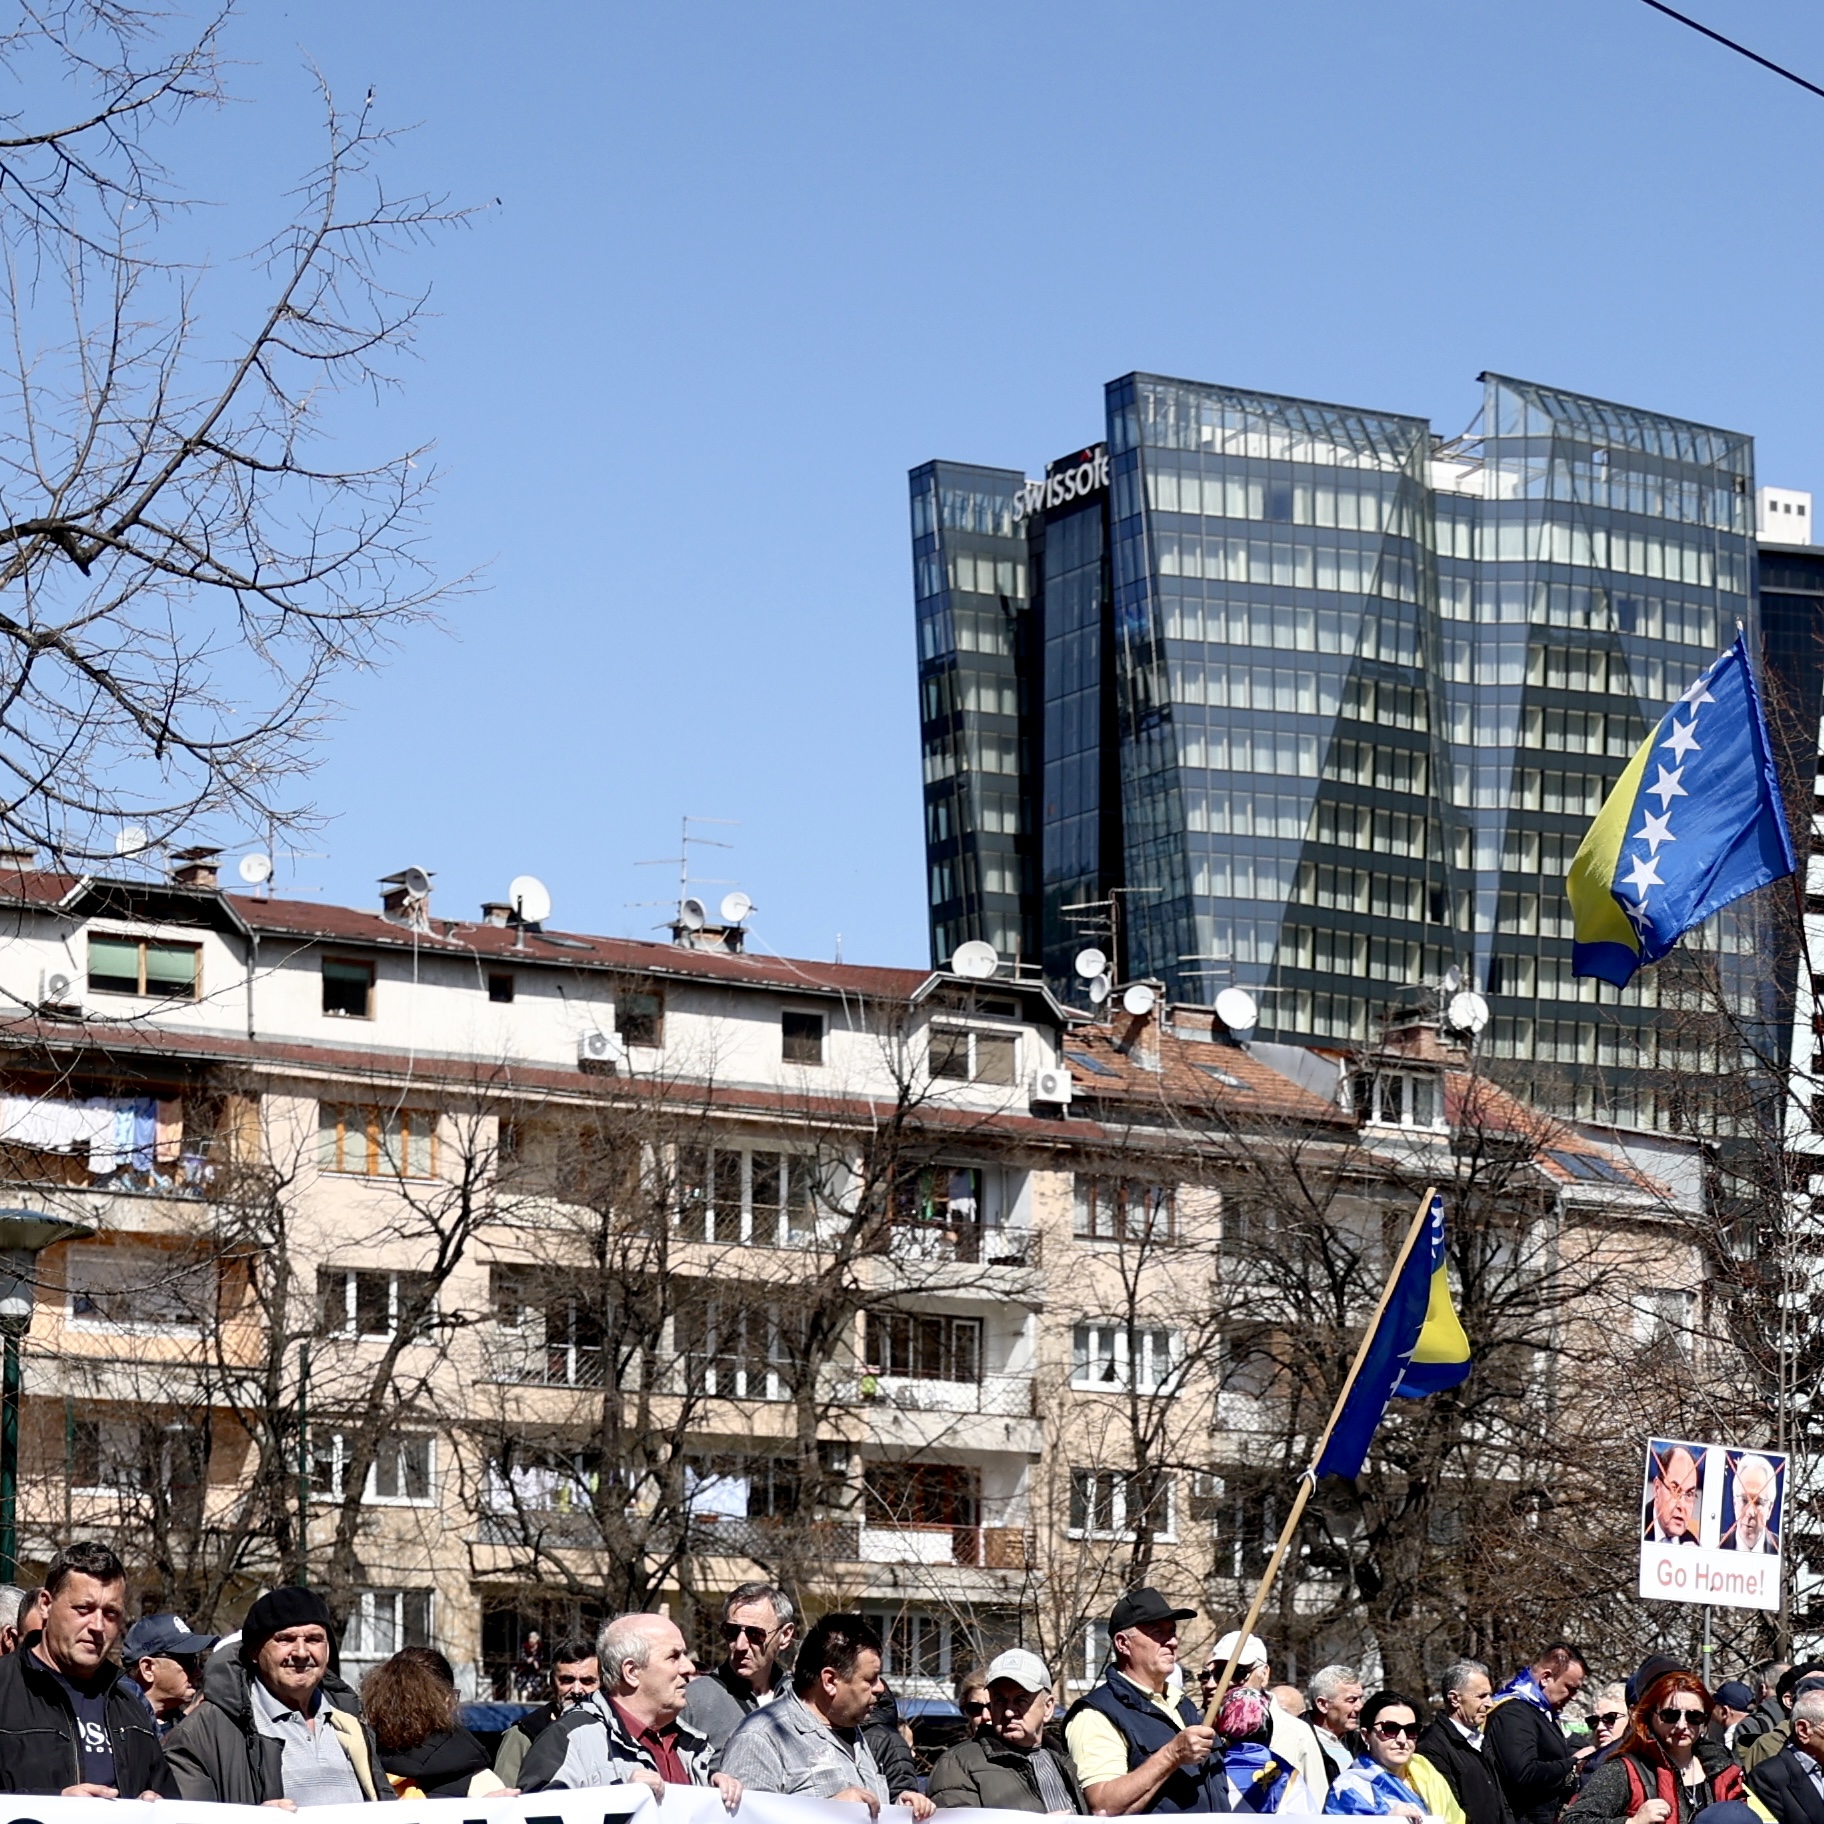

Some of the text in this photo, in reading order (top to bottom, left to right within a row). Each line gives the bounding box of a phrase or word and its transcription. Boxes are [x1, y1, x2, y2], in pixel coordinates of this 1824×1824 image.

[1013, 447, 1110, 522] swissôte
[1657, 1558, 1765, 1596] Go Home!
